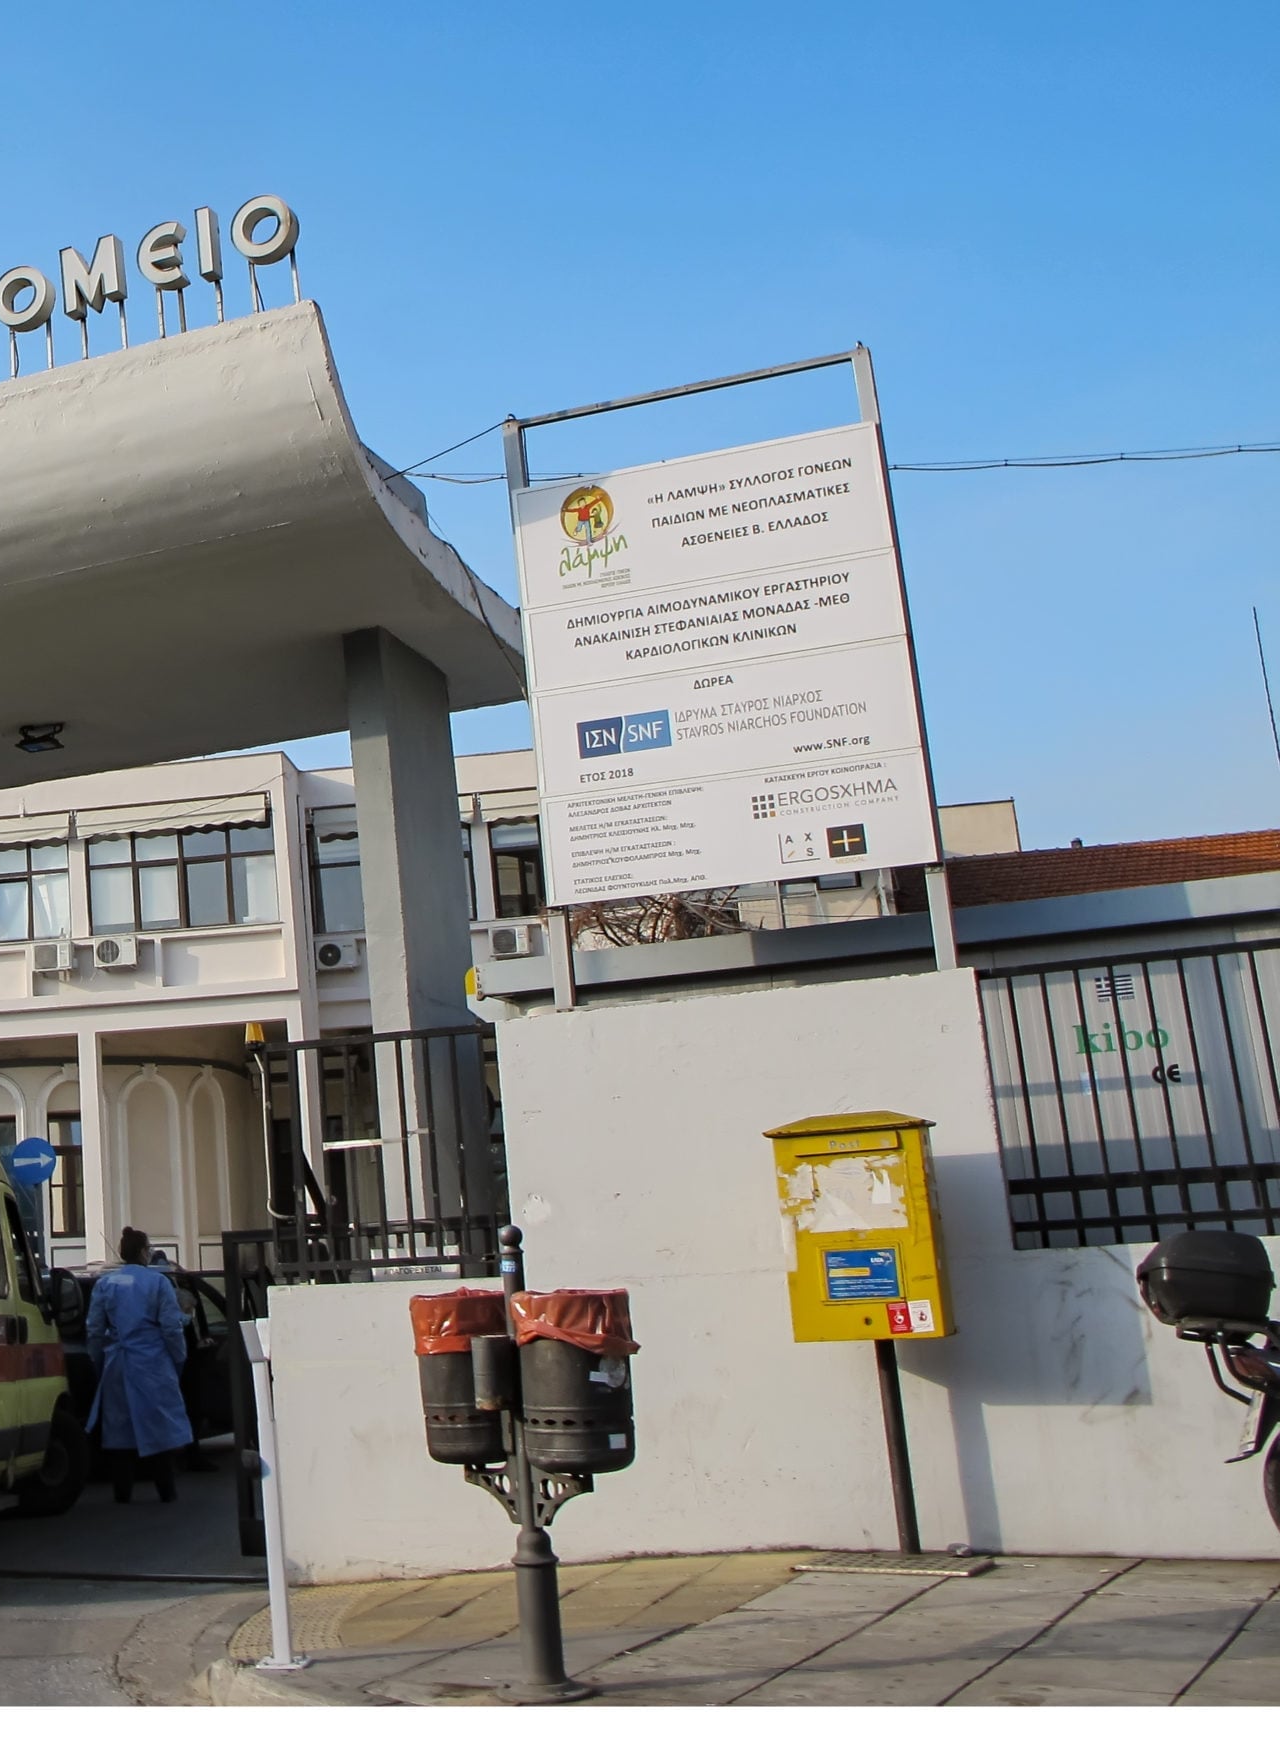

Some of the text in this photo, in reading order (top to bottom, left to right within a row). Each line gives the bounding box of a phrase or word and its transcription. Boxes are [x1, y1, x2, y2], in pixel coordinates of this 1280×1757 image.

[647, 457, 852, 505] «Η ΛΑΜΨΗ» ΣΥΛΛΟΓΟΣ ΓΟΝΕΩΝ
[651, 482, 851, 529] ΠΑΙΔΙΩΝ ΜΕ ΝΕΟΠΛΑΣΜΑΤΙΚΕΣ
[681, 511, 829, 548] ΑΣΘΕΝΕΙΕΣ Β. ΕΛΛΑΔΟΣ
[559, 534, 628, 579] λάμψη
[567, 572, 851, 630] ΔΗΜΙΟΥΡΓΙΑ ΑΙΜΟΔΥΝΑΜΙΚΟΥ ΕΡΓΑΣΤΗΡΙΟΥ
[574, 626, 651, 648] ΑΝΑΚΑΙΝΙΣΗ
[654, 610, 740, 635] ΣΤΕΦΑΝΙΑΙΑΣ
[742, 600, 811, 621] ΜΟΝΑΔΑΣ
[625, 623, 797, 661] ΚΑΡΔΙΟΛΟΓΙΚΩΝ ΚΛΙΝΙΚΩΝ
[693, 674, 734, 690] ΔΩΡΕΑ
[674, 690, 823, 724] ΙΔΡΥΜΑ ΣΤΑΥΡΟΣ ΝΙΑΡΧΟΣ
[676, 701, 868, 741] STAVROS NIARCHOS FOUNDATION
[585, 720, 664, 749] ΙΣΝ SNF
[793, 736, 871, 754] www.SNF.org
[579, 767, 635, 784] ΕΤΟΣ 2018
[764, 772, 806, 784] ΚΑΤΑΣΚΕΥΗ
[807, 768, 829, 778] ΕΡΓΟΥ
[778, 778, 898, 807] ERGOSXHMA
[780, 795, 899, 816] CONSTRUCTION COMPANY
